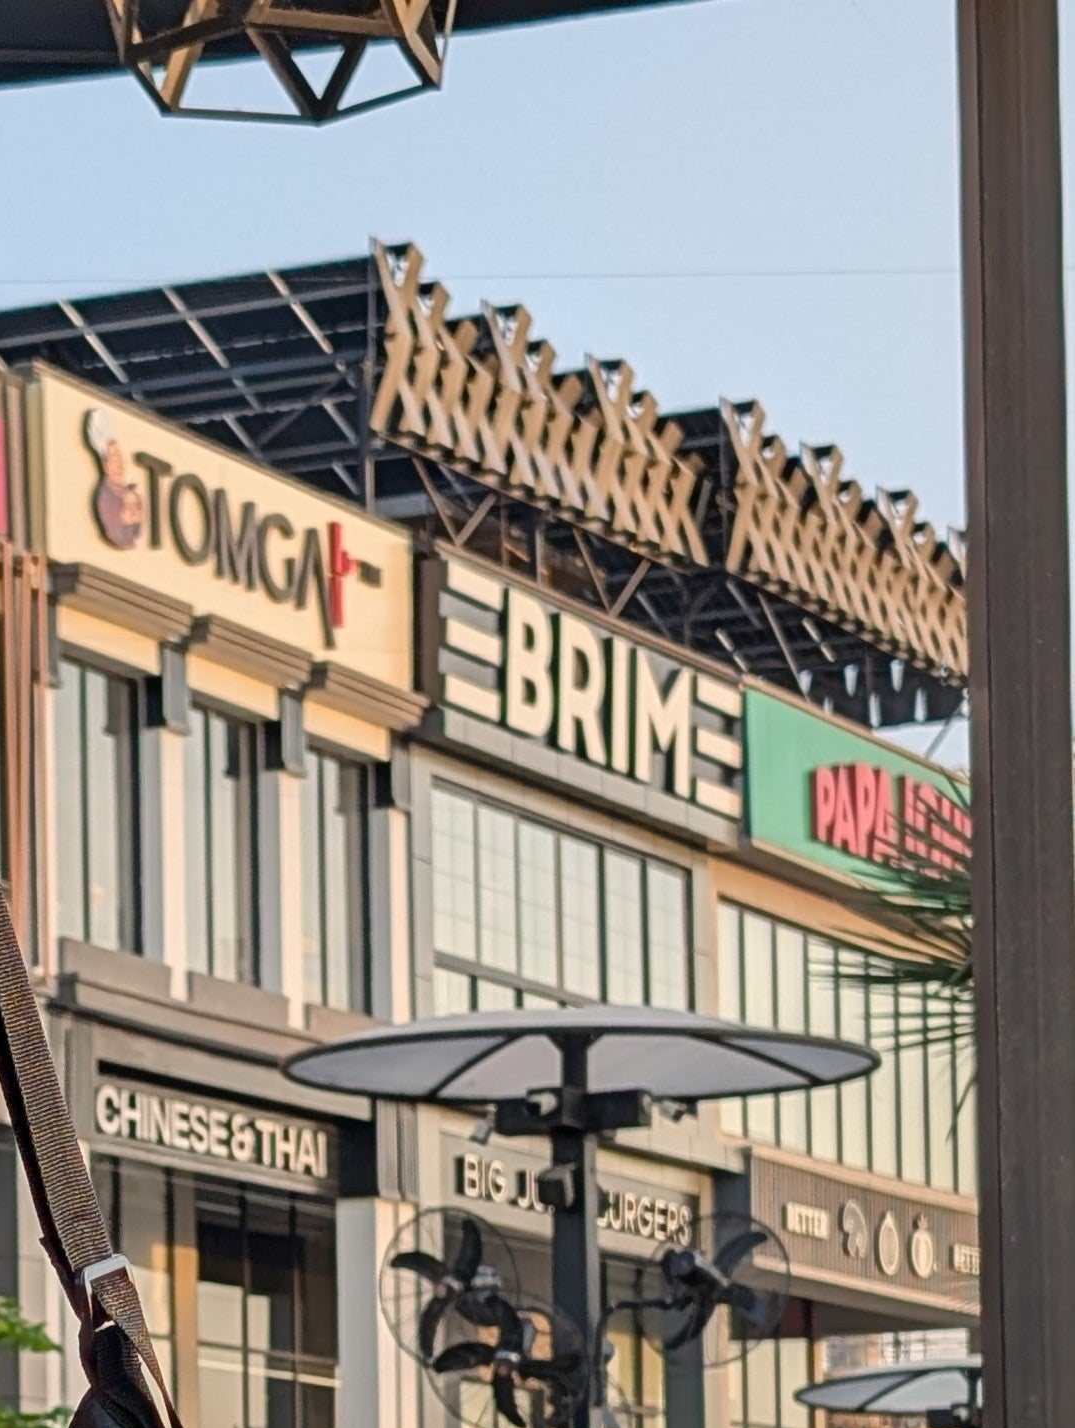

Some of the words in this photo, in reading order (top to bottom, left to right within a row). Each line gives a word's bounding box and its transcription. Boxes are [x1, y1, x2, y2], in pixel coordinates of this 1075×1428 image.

[505, 586, 693, 800] BRIM
[811, 761, 900, 865] PAPA
[462, 1152, 508, 1203] BIG
